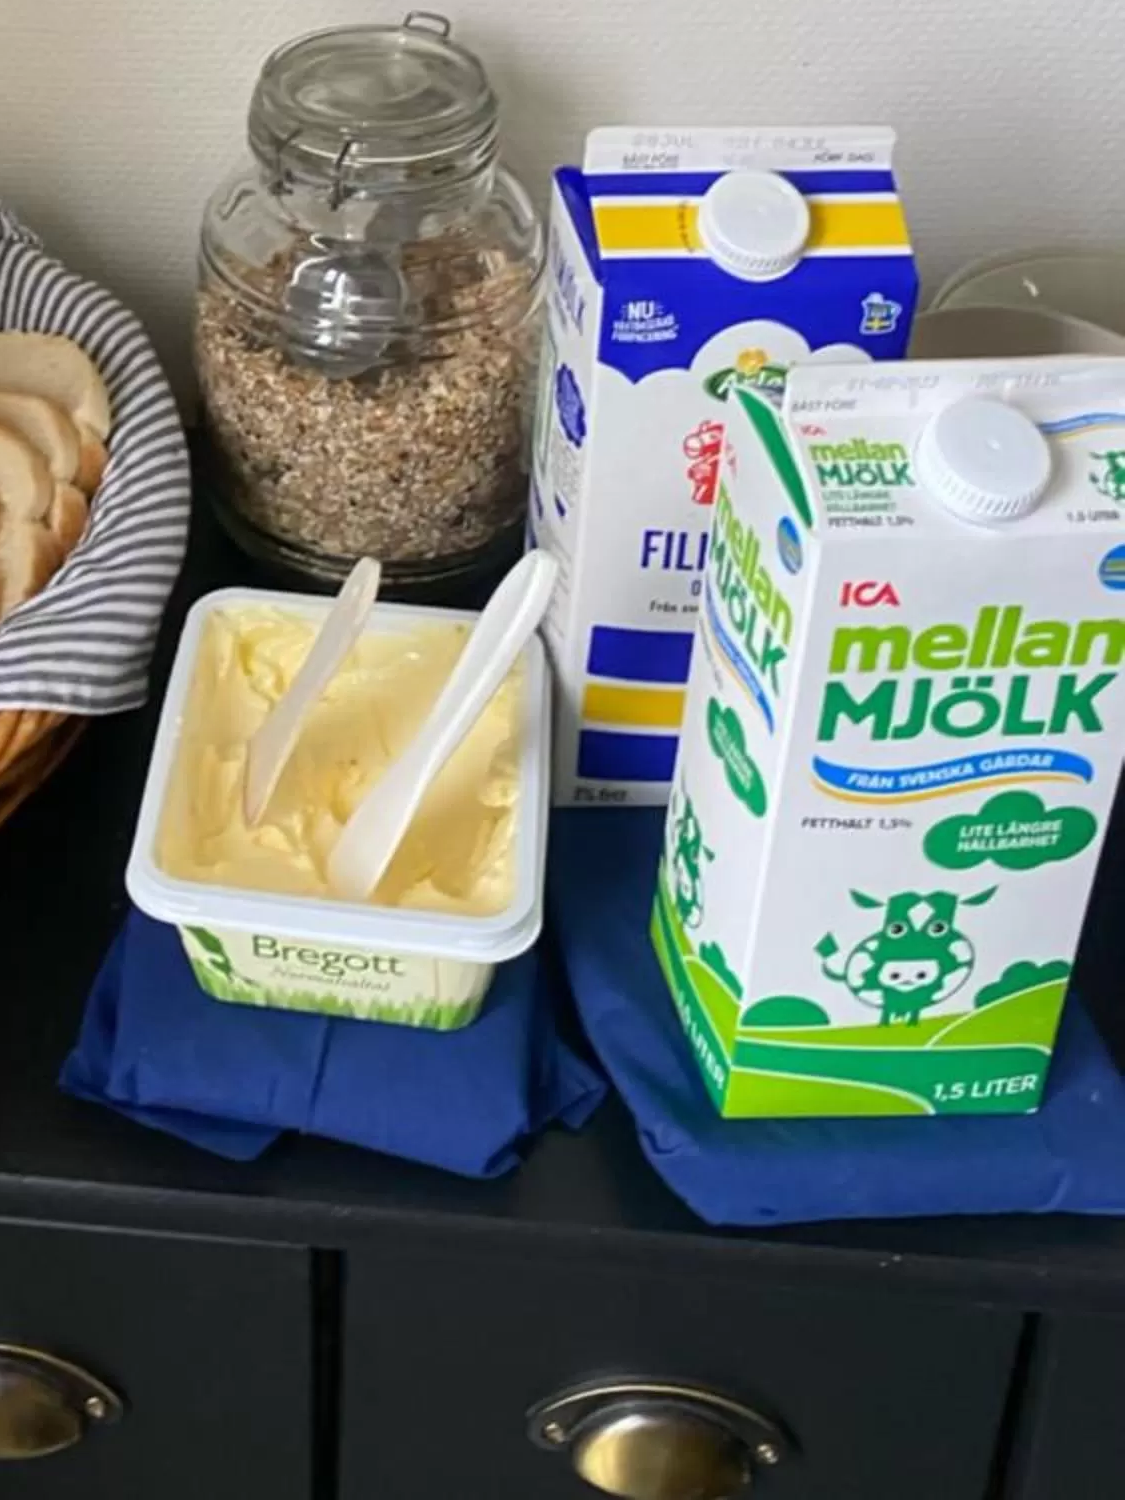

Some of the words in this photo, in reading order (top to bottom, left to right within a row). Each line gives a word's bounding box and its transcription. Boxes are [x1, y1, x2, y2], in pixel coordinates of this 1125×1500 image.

[627, 299, 655, 320] NU
[808, 437, 908, 462] mellan
[815, 461, 916, 488] MJÖLK
[715, 482, 793, 647] mellan
[840, 581, 901, 608] ICA
[827, 604, 1125, 675] mellan
[816, 672, 1118, 743] MJÖLK
[846, 769, 896, 790] FRÅN
[899, 762, 976, 789] SVENSKA
[979, 752, 1056, 773] GÅRDAR
[800, 815, 875, 830] FETTHALT
[958, 823, 994, 840] LITE
[995, 817, 1064, 837] LÄNGRE
[956, 832, 1062, 853] HÅLLBARHET
[251, 933, 407, 978] Bregott
[933, 1081, 967, 1102] 1,5
[969, 1072, 1039, 1099] LITER
